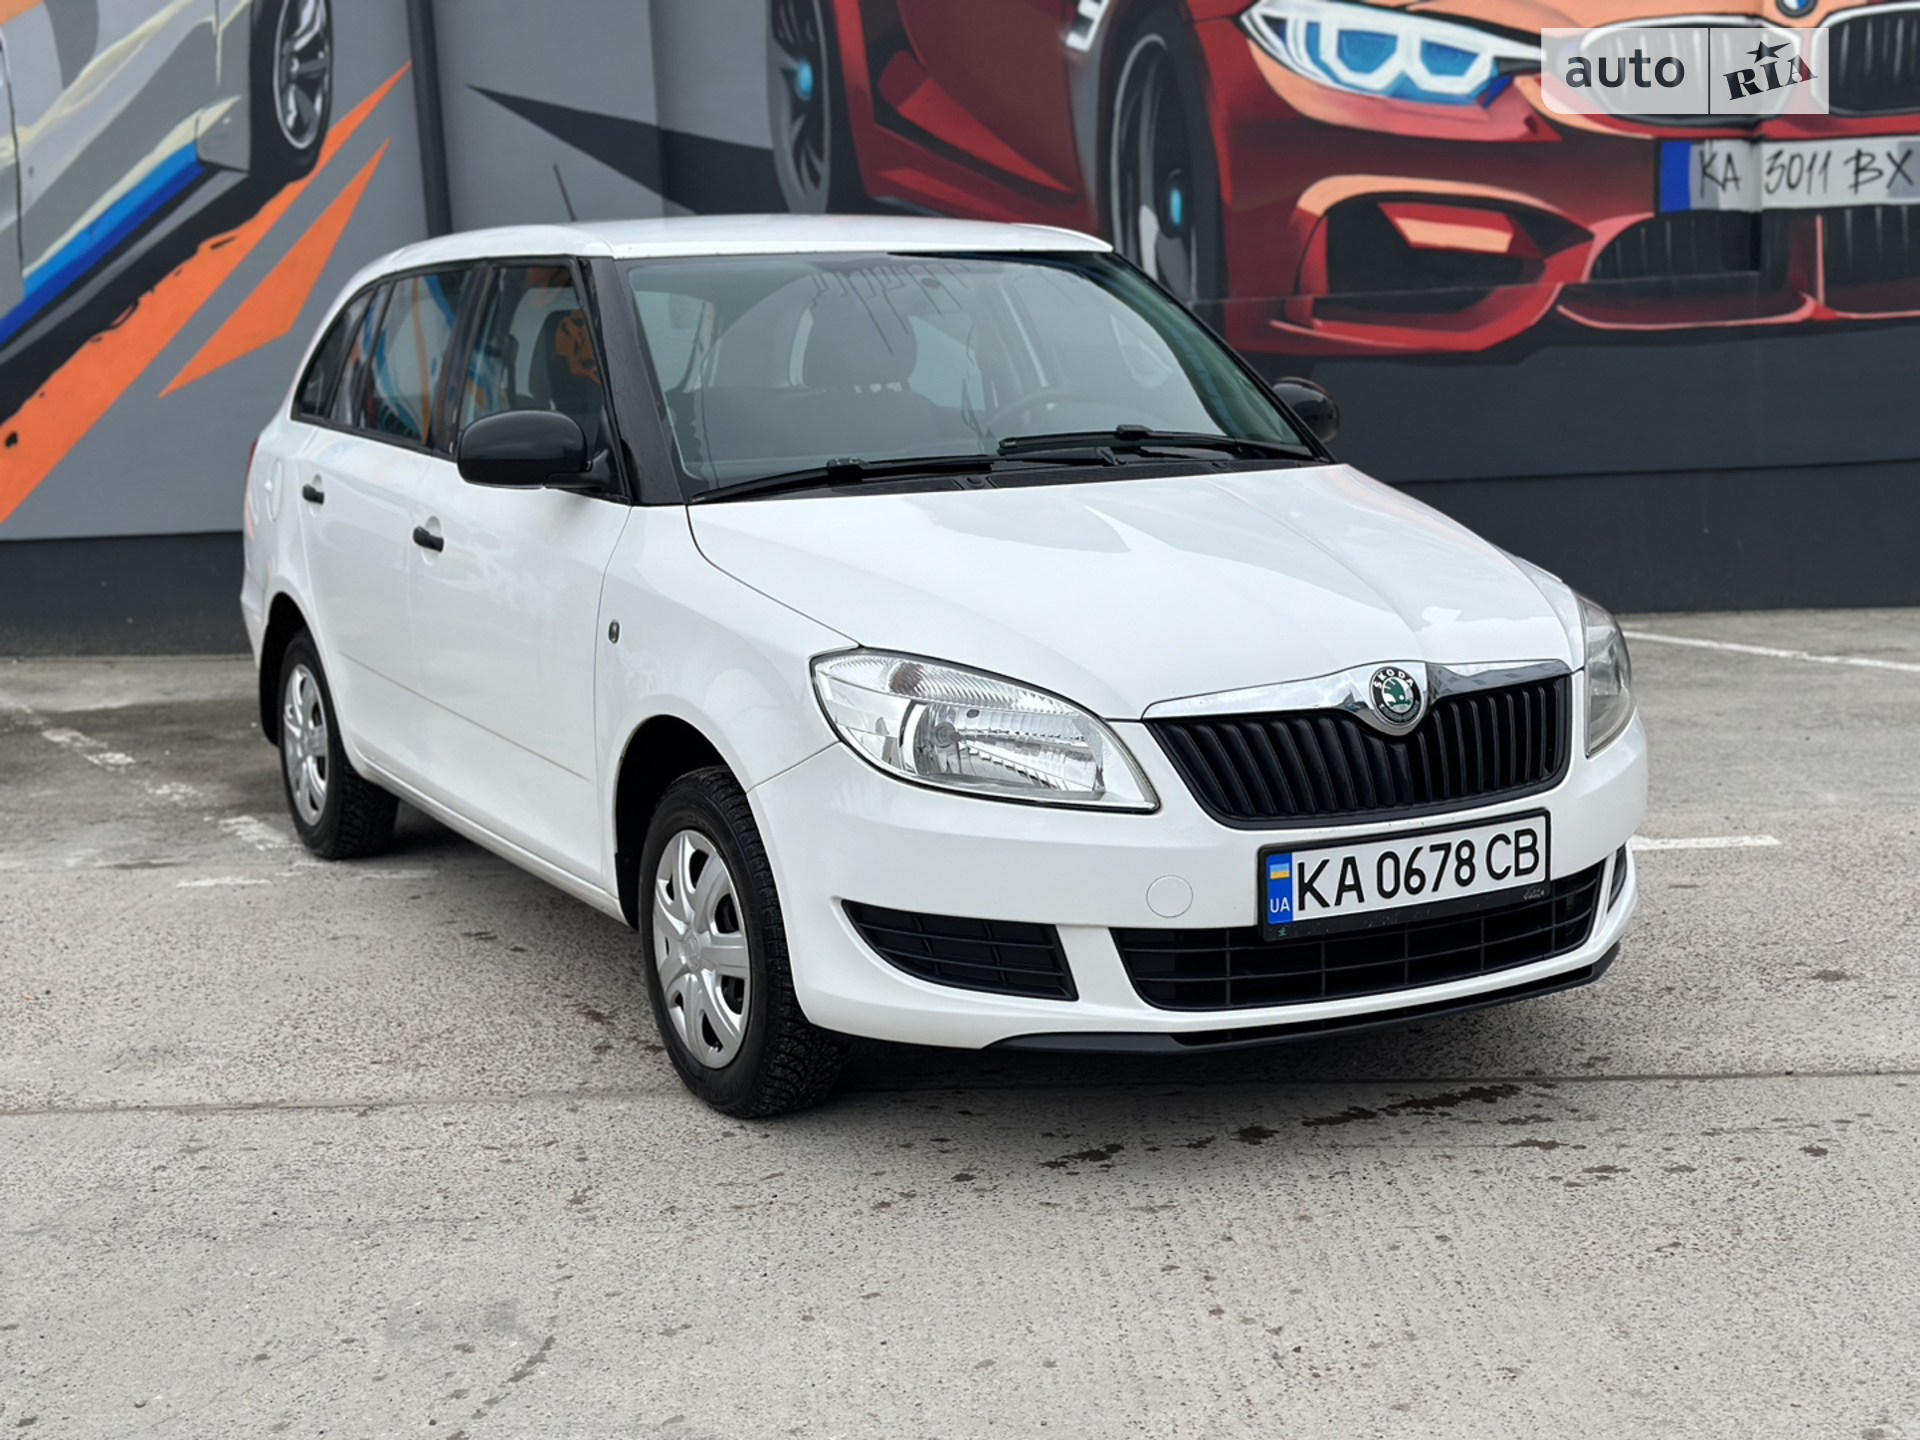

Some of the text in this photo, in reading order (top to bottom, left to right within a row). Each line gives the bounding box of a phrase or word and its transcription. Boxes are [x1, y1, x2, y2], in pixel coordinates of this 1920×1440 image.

[1699, 149, 1741, 199] KA
[1297, 828, 1539, 911] KA 0678 CB
[1270, 897, 1290, 913] UA
